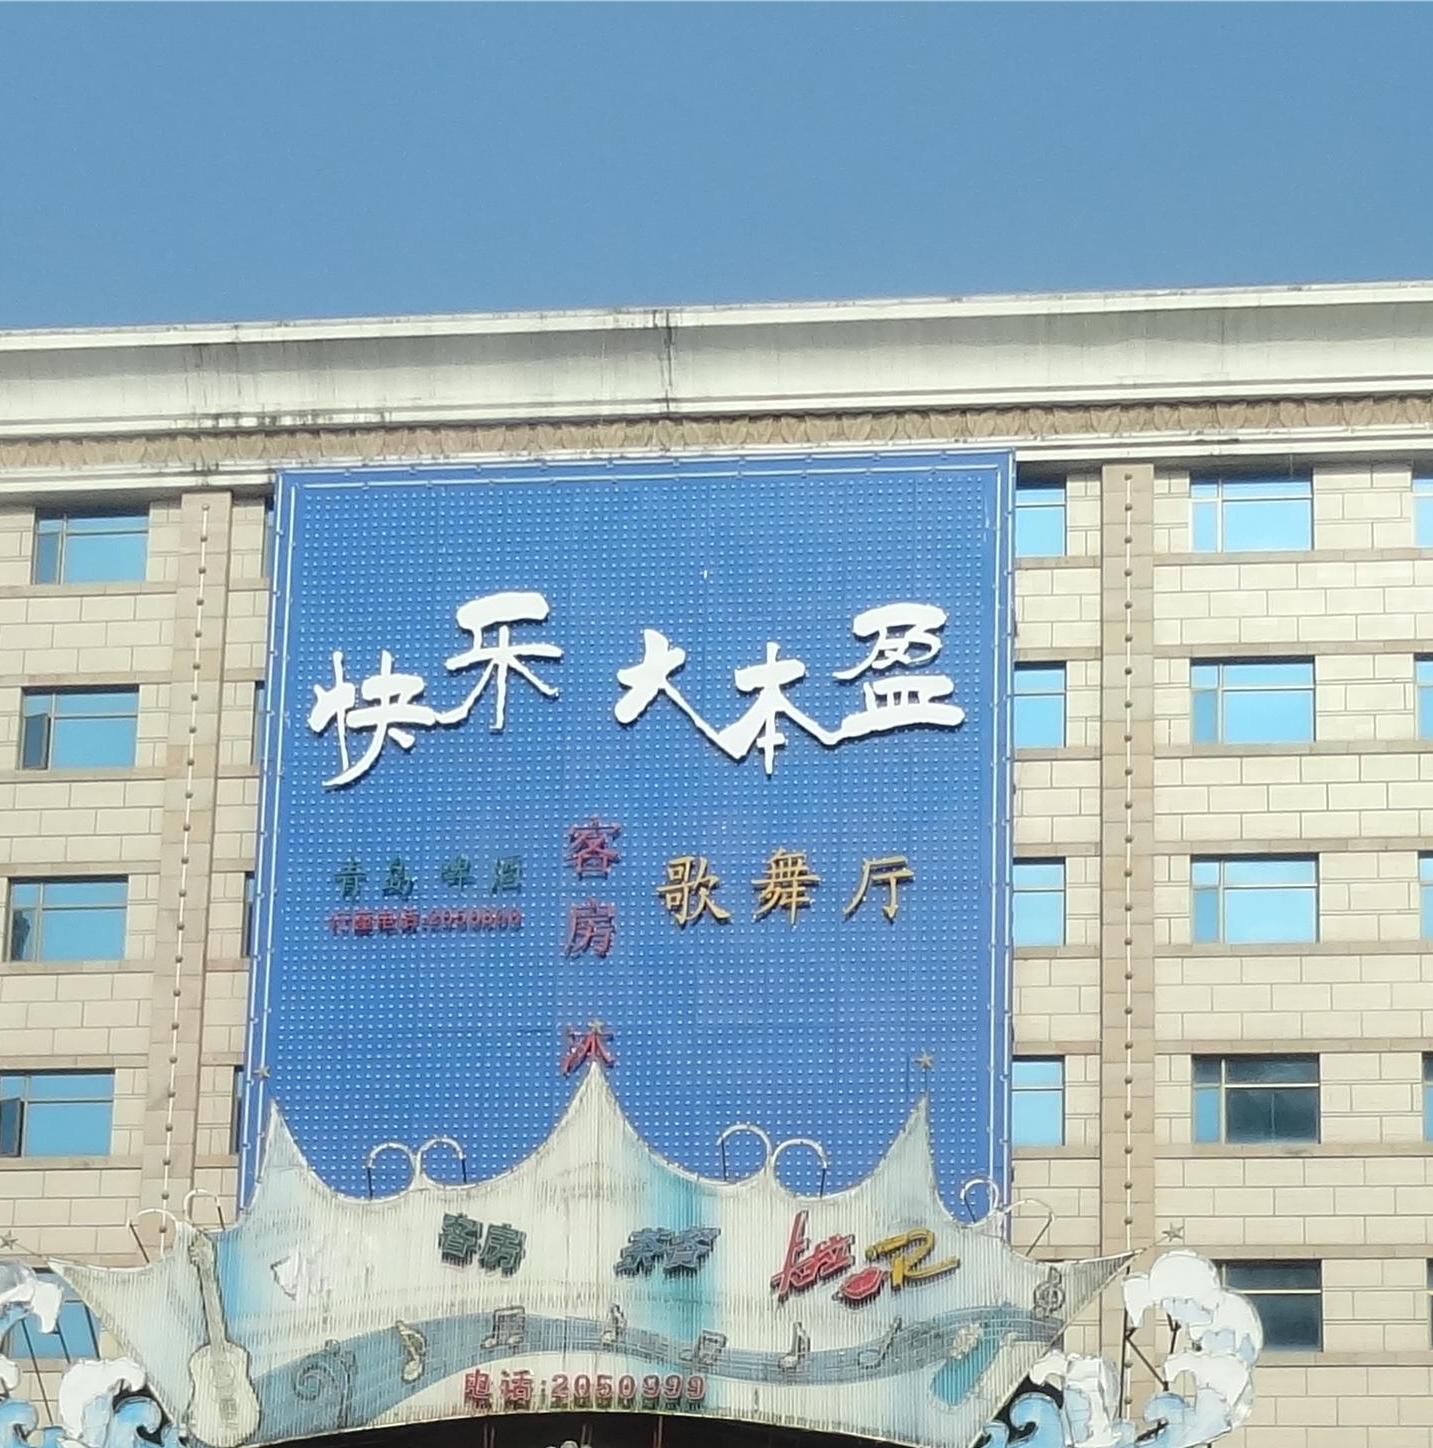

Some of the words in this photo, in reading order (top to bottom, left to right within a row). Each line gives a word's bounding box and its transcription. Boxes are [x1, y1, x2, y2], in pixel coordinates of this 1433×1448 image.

[566, 816, 621, 957] 客房
[659, 848, 914, 927] 歌舞厅
[438, 1212, 525, 1274] 客房
